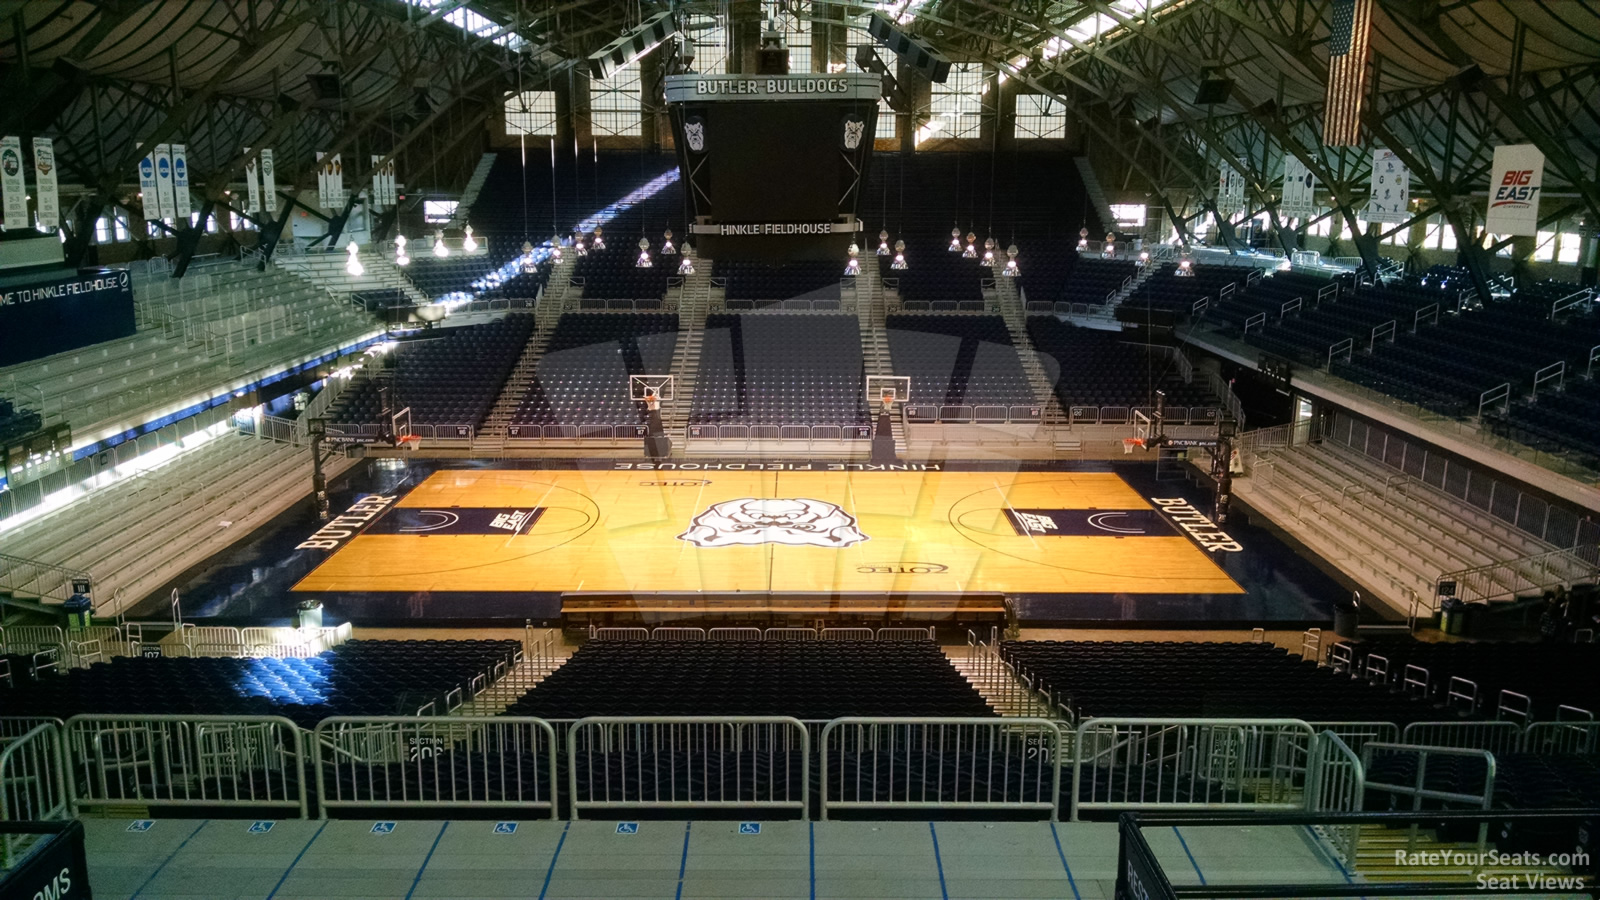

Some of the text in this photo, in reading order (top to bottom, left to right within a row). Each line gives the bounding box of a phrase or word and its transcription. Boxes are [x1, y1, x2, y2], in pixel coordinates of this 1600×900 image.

[697, 79, 848, 94] BUTLER BULLDOGS
[1501, 170, 1533, 185] BIG
[1495, 186, 1540, 200] EAST
[721, 224, 831, 235] HINKLE FIELDHOUSE
[16, 290, 31, 303] TO
[32, 284, 66, 301] HINKLE
[66, 277, 118, 296] FIELDHOUSE
[827, 463, 941, 471] HINKLE
[295, 495, 398, 550] BUTLER
[489, 513, 511, 528] BIG
[501, 510, 527, 531] EAST
[1151, 497, 1244, 553] BUTLER
